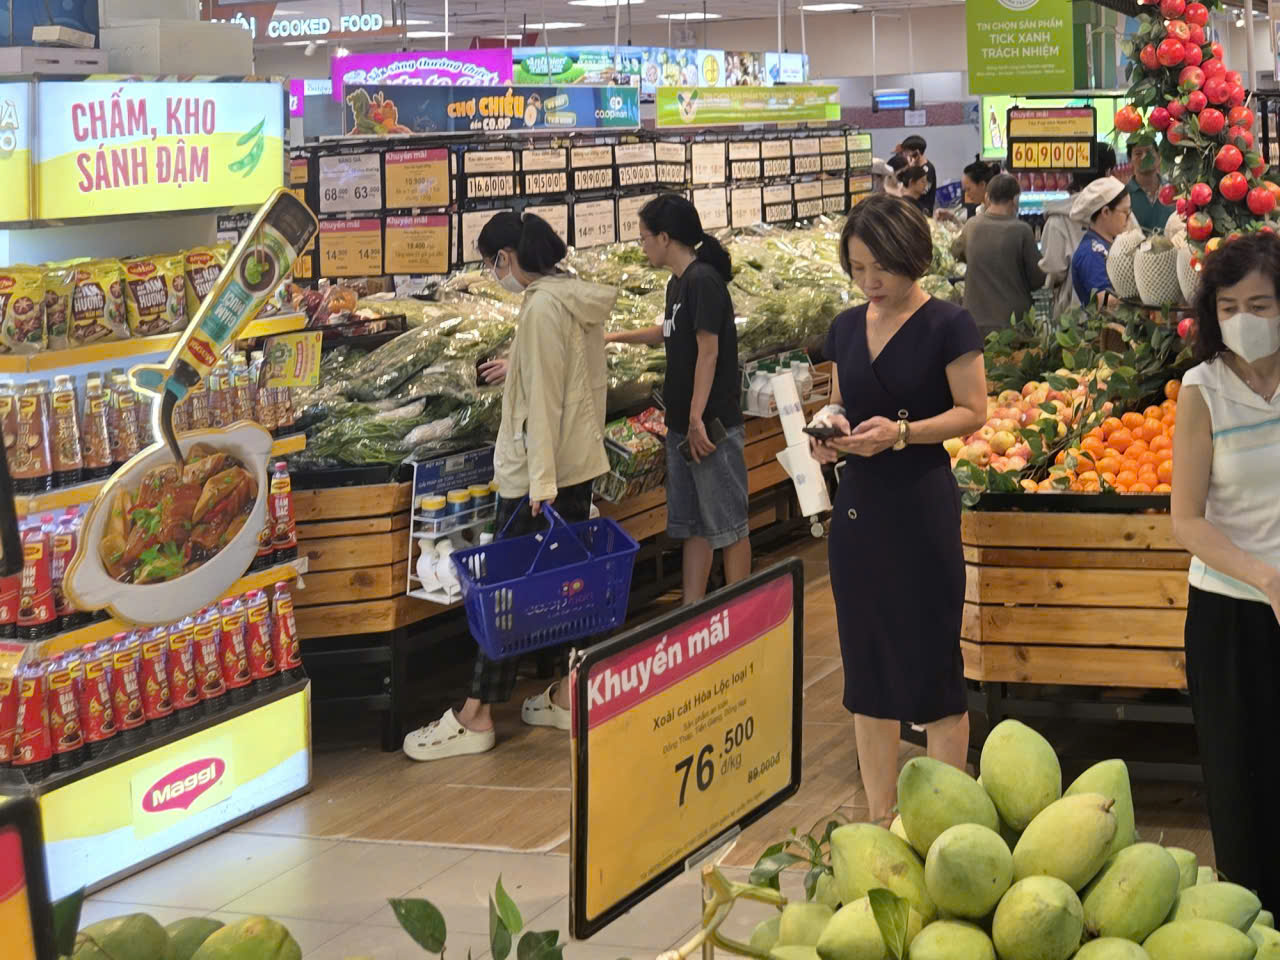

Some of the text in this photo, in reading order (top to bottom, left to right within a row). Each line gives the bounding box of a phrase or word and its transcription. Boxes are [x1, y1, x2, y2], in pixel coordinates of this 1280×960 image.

[268, 18, 331, 38] COOKED
[340, 13, 383, 33] FOOD
[976, 16, 1063, 31] TIN CHỌN SẢN PHẨM
[989, 31, 1050, 44] TICK XANH
[982, 43, 1059, 60] TRÁCH NHIỆM
[448, 98, 476, 119] CHỢ
[479, 88, 525, 118] CHIỀU
[71, 88, 157, 142] CHẤM,
[166, 98, 215, 136] KHO
[483, 118, 511, 130] CO.OP
[385, 150, 413, 161] Khuyến
[1015, 145, 1074, 162] 60.900
[77, 140, 209, 193] SÁNH ĐẬM
[320, 221, 345, 231] Khuyến
[386, 216, 413, 226] Khuyến
[74, 296, 104, 312] HƯƠNG
[139, 291, 166, 308] HƯƠNG
[587, 608, 730, 711] Khuyến mãi
[653, 709, 675, 731] Xoài
[677, 699, 692, 717] cát
[694, 689, 711, 707] Hòa
[714, 678, 730, 696] Lộc
[732, 665, 747, 685] loại
[720, 752, 742, 777] đ/kg
[675, 744, 714, 808] 76
[153, 762, 216, 808] Maggi
